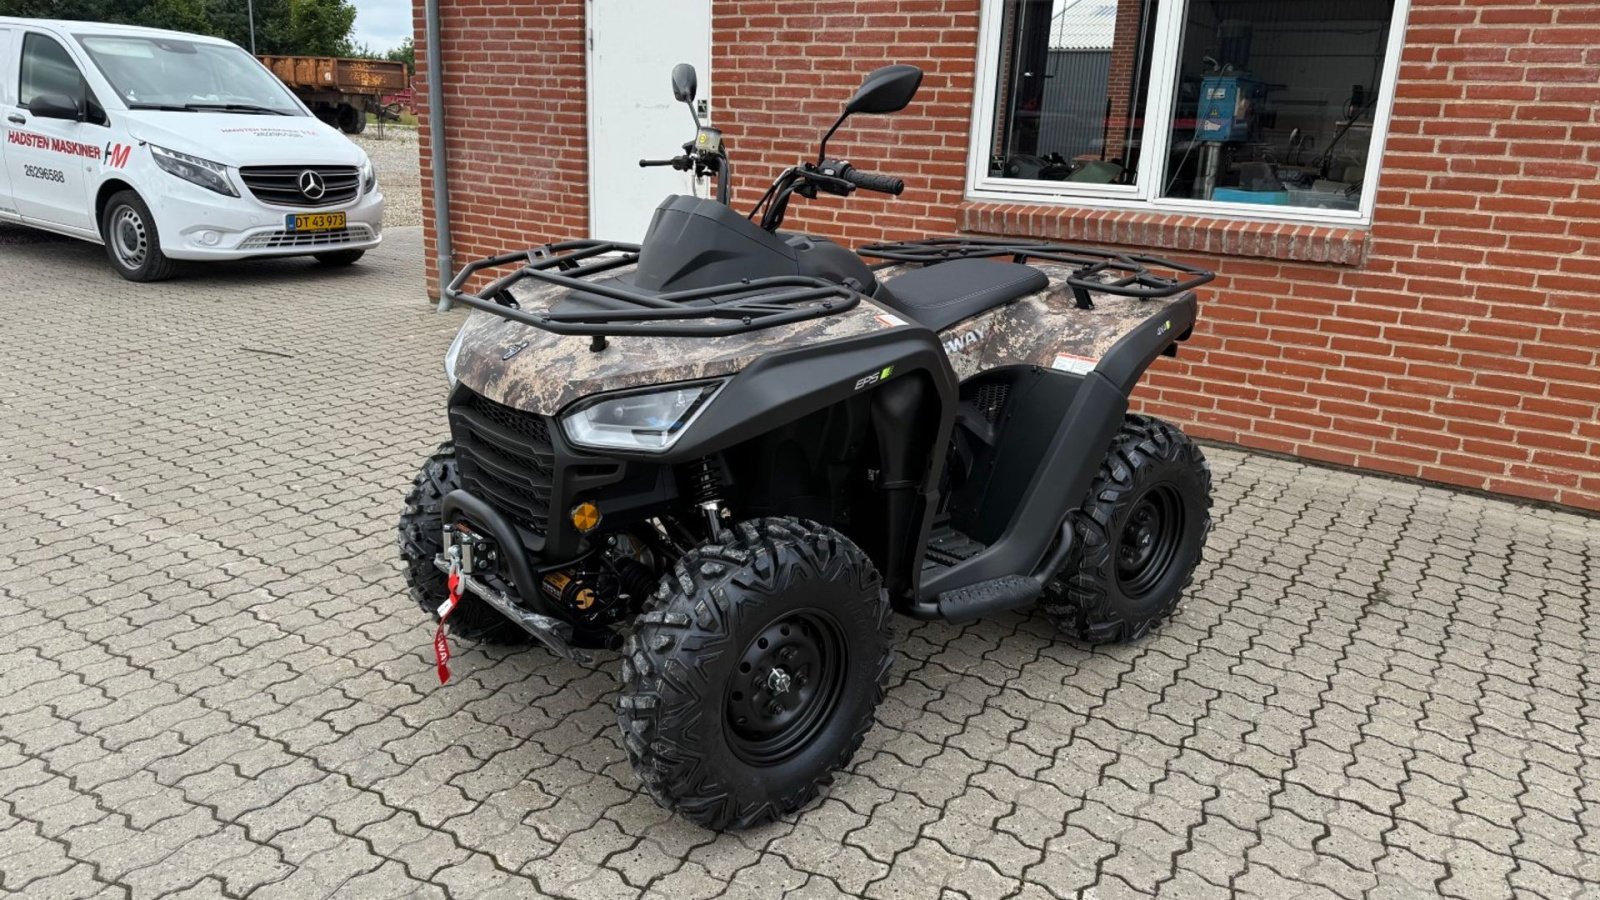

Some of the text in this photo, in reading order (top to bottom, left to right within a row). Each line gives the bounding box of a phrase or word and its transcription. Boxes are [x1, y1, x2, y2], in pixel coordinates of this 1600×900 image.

[8, 130, 101, 159] HADSTEN MASKINER
[24, 164, 65, 183] 26296588
[296, 214, 343, 228] DT 43 973
[854, 371, 880, 390] EPS
